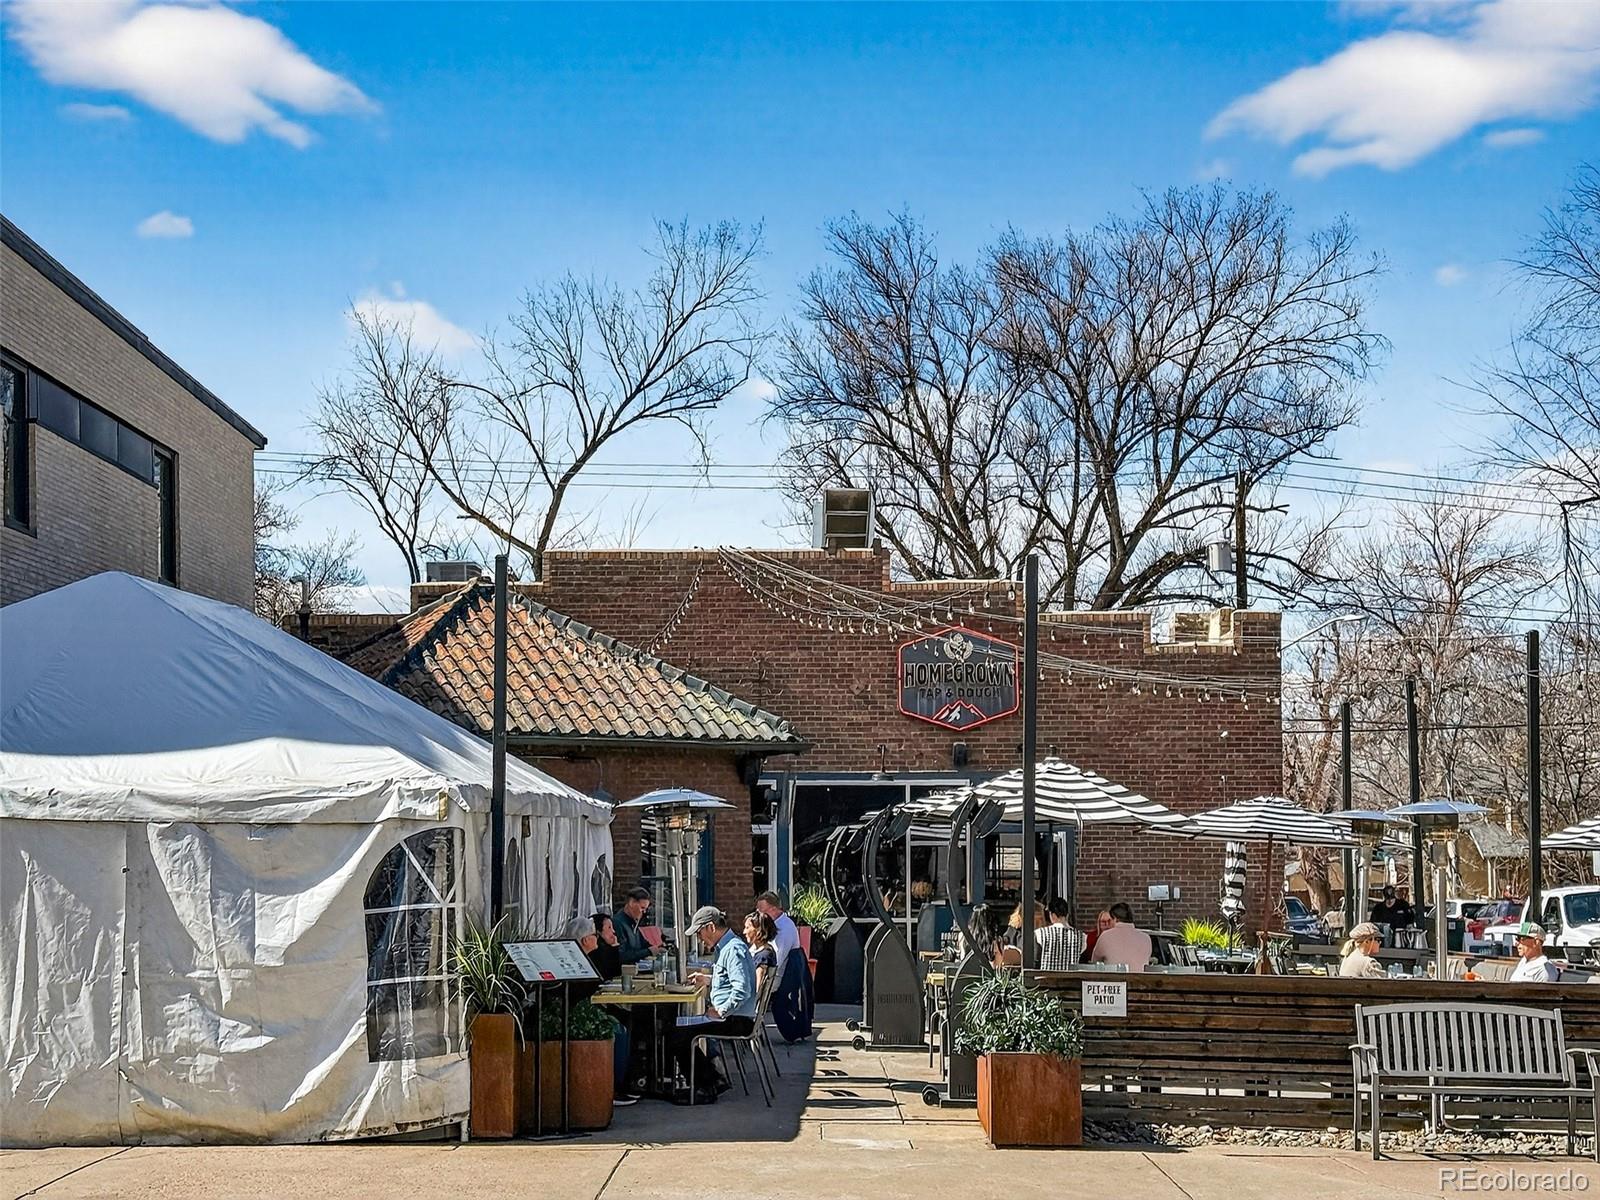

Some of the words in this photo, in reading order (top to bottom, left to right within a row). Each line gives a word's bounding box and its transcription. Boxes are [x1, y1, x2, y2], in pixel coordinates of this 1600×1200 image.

[904, 662, 1015, 688] HOMEGROWN
[920, 687, 942, 698] TAP
[945, 688, 953, 698] &
[957, 687, 1001, 698] DOUGH
[1087, 984, 1121, 995] PET-FREE
[1094, 995, 1115, 1005] PATIO
